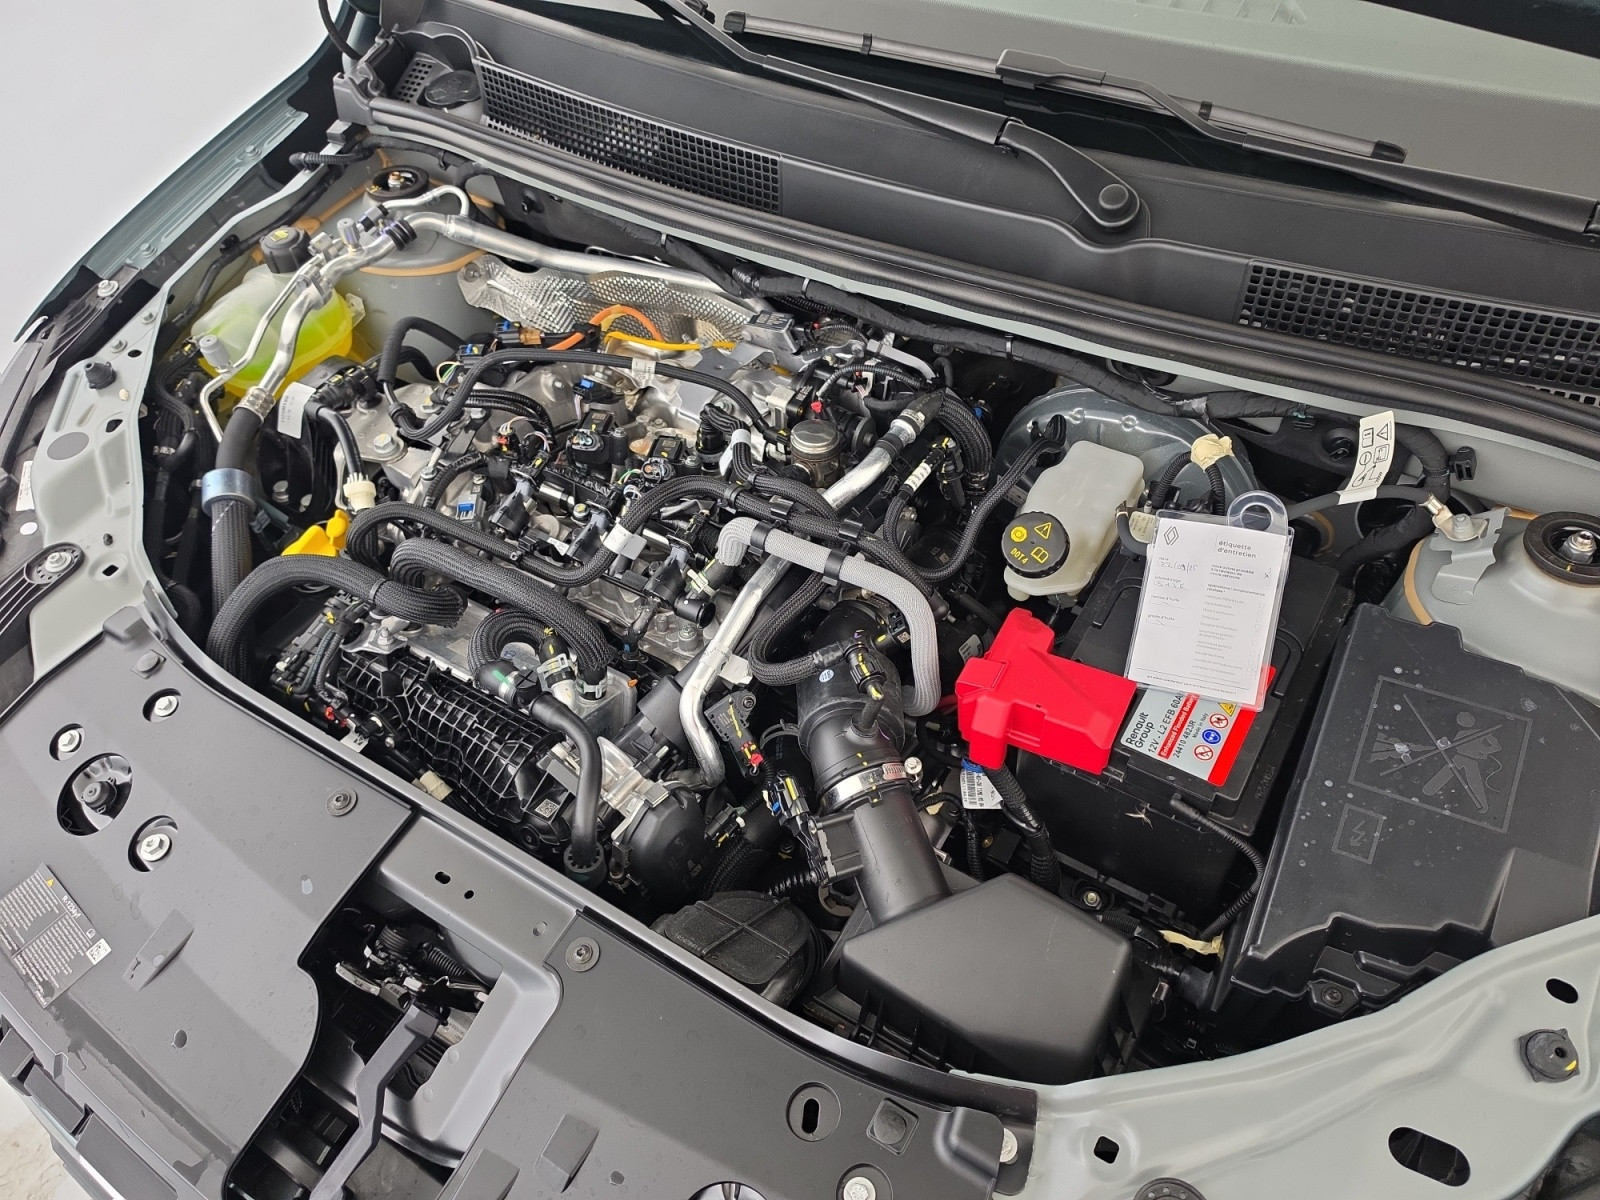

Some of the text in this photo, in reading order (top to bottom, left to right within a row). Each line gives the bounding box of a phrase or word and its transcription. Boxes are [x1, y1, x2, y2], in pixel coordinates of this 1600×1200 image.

[1217, 547, 1256, 558] d'entretien
[1218, 540, 1252, 550] étiquette
[1126, 712, 1148, 745] Renault
[1134, 722, 1154, 748] Group
[1148, 738, 1159, 753] 12V
[1157, 725, 1167, 735] L2
[1162, 709, 1175, 725] EFB
[1160, 732, 1178, 756] Enhanced
